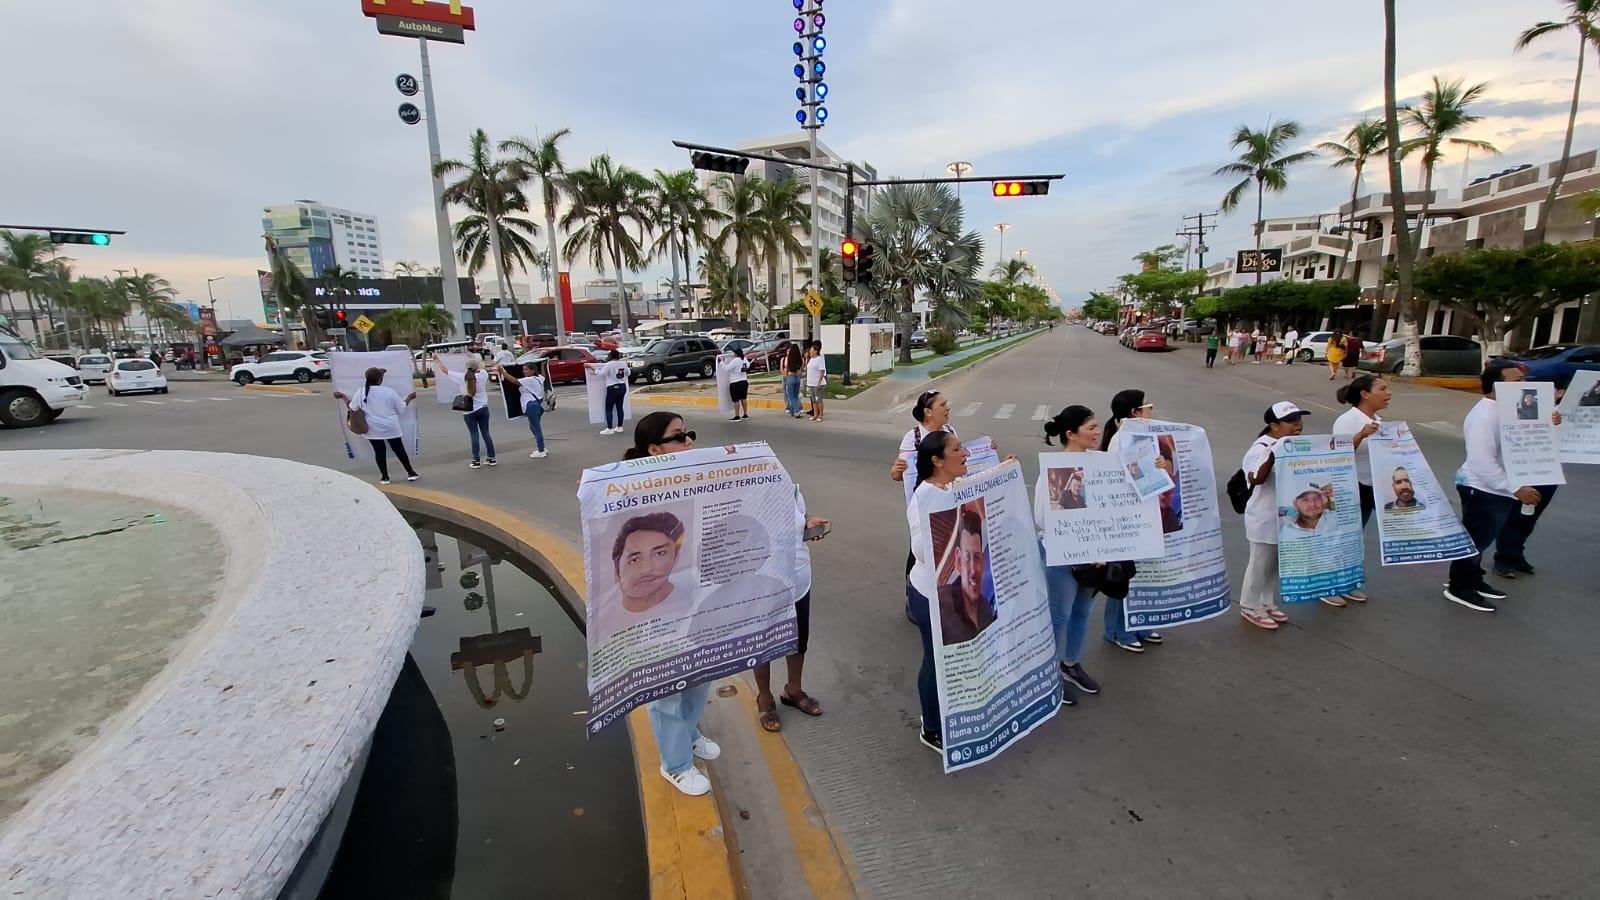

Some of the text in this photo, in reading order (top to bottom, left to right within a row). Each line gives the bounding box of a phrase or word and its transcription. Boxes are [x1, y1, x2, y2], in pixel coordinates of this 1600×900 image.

[398, 20, 443, 34] AutoMac
[400, 77, 414, 88] 24
[1242, 257, 1277, 270] Digo
[628, 454, 677, 468] Sinaloa
[696, 471, 704, 480] a
[708, 463, 768, 479] encontrar
[1092, 469, 1126, 478] Queremo
[602, 474, 782, 514] JESÚS BRYAN ENRIQUEZ TERRONES
[954, 487, 975, 503] DANIEL
[1058, 519, 1071, 528] No
[1063, 545, 1137, 560] Daniel Palomares
[592, 694, 602, 704] Si
[604, 677, 629, 697] tienes
[693, 641, 734, 659] referente
[736, 639, 743, 647] a
[746, 633, 763, 644] esta
[592, 697, 614, 713] llama
[616, 688, 623, 697] o
[682, 663, 692, 672] Tu
[694, 652, 721, 668] ayuda
[723, 650, 734, 659] es
[735, 643, 754, 657] muy
[613, 699, 634, 721] (669)
[949, 718, 957, 727] Si
[960, 712, 985, 725] tienes
[950, 727, 972, 740] llama
[976, 743, 989, 755] 669
